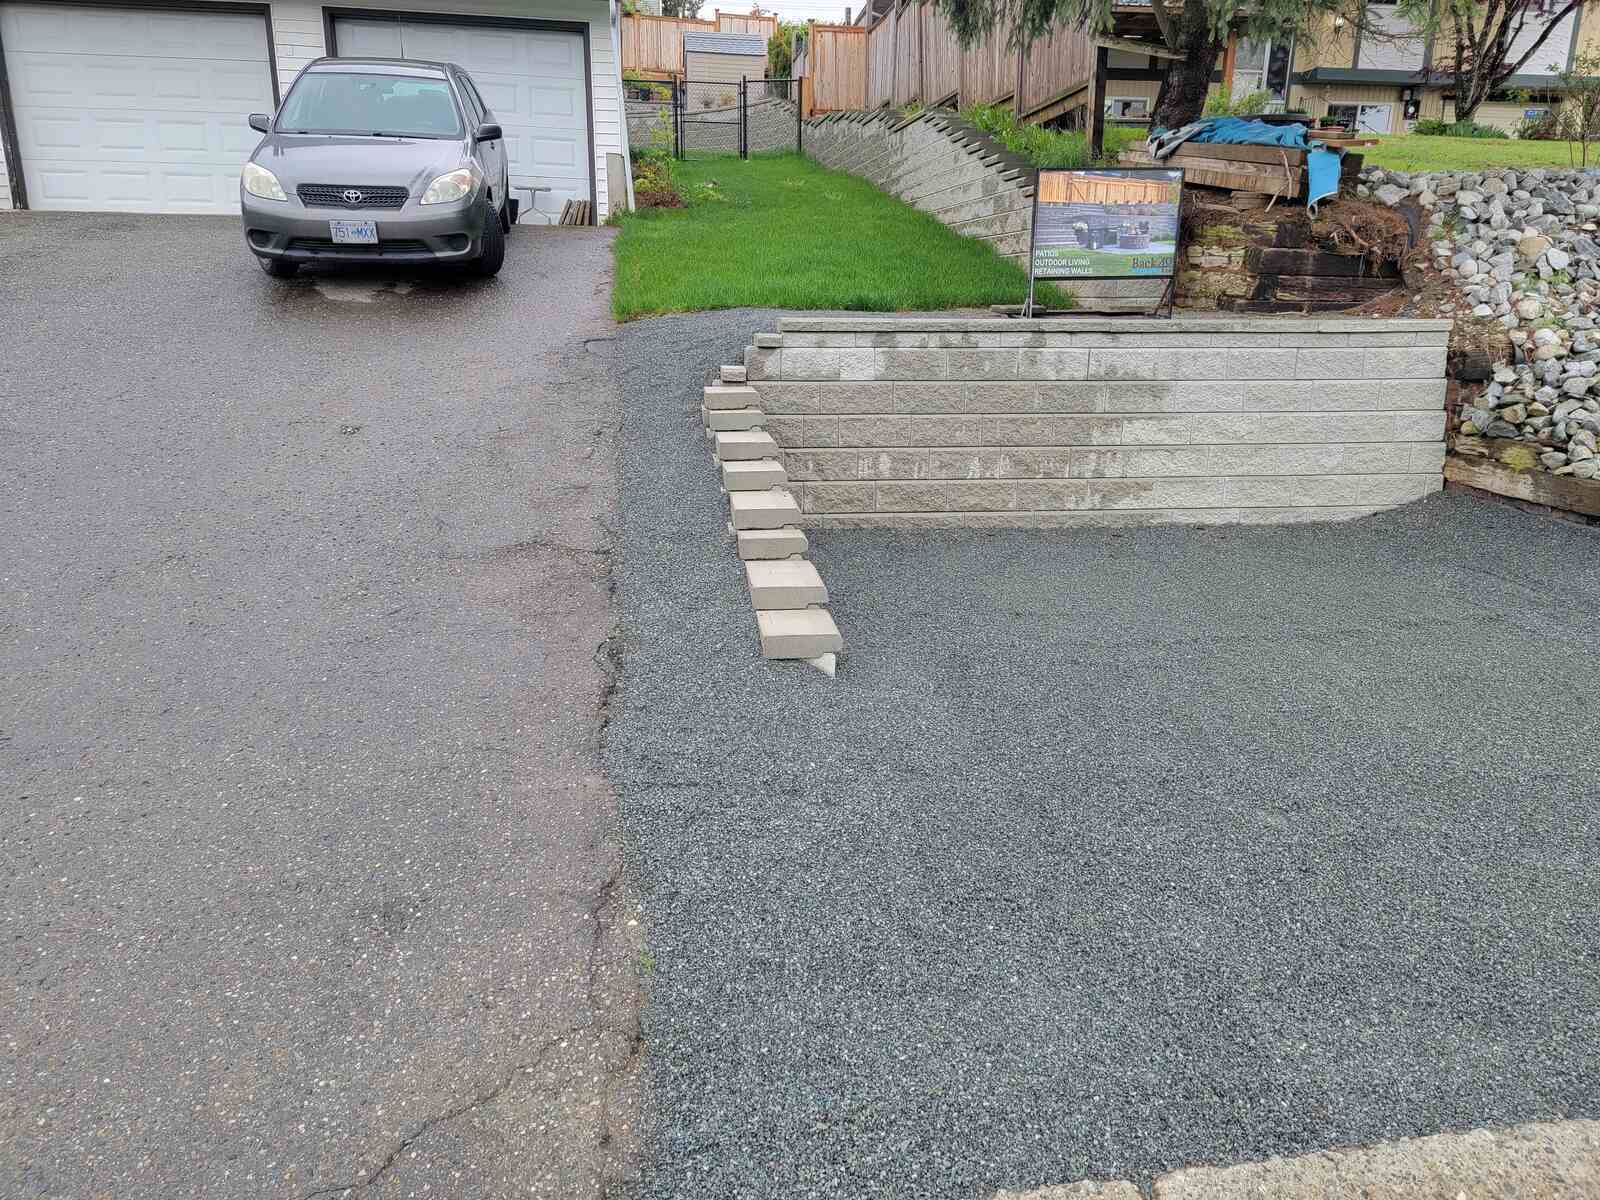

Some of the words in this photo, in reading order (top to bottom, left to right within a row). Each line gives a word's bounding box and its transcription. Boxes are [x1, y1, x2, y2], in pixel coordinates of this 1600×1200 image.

[1035, 249, 1059, 257] PATIOS
[1034, 258, 1066, 266] OUTDOOR
[1067, 256, 1090, 266] LIVING
[1034, 267, 1070, 275] RETAINING
[1071, 266, 1093, 274] WALLS
